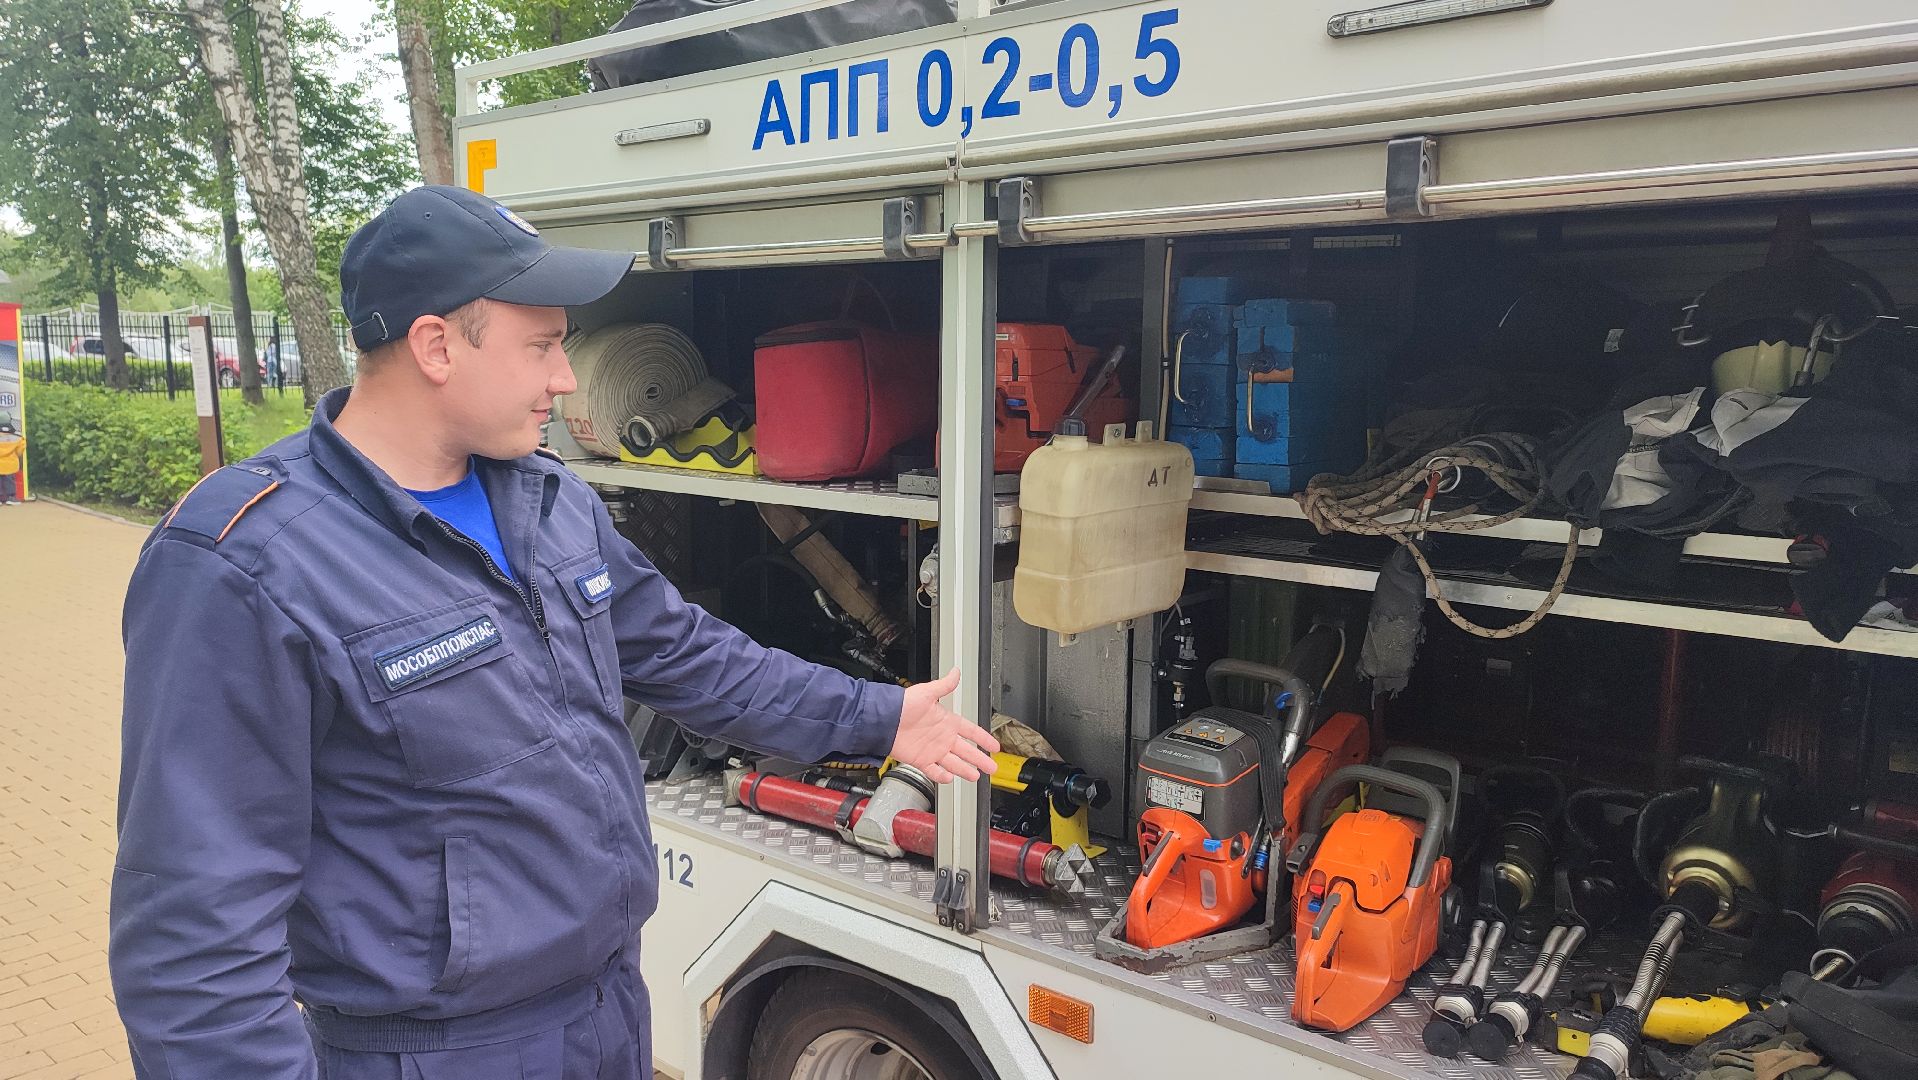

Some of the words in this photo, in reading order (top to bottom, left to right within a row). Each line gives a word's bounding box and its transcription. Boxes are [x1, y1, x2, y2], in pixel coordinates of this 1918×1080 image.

[752, 58, 889, 151] АПП
[916, 8, 1181, 140] 0,2-0,5
[653, 843, 694, 889] 12
